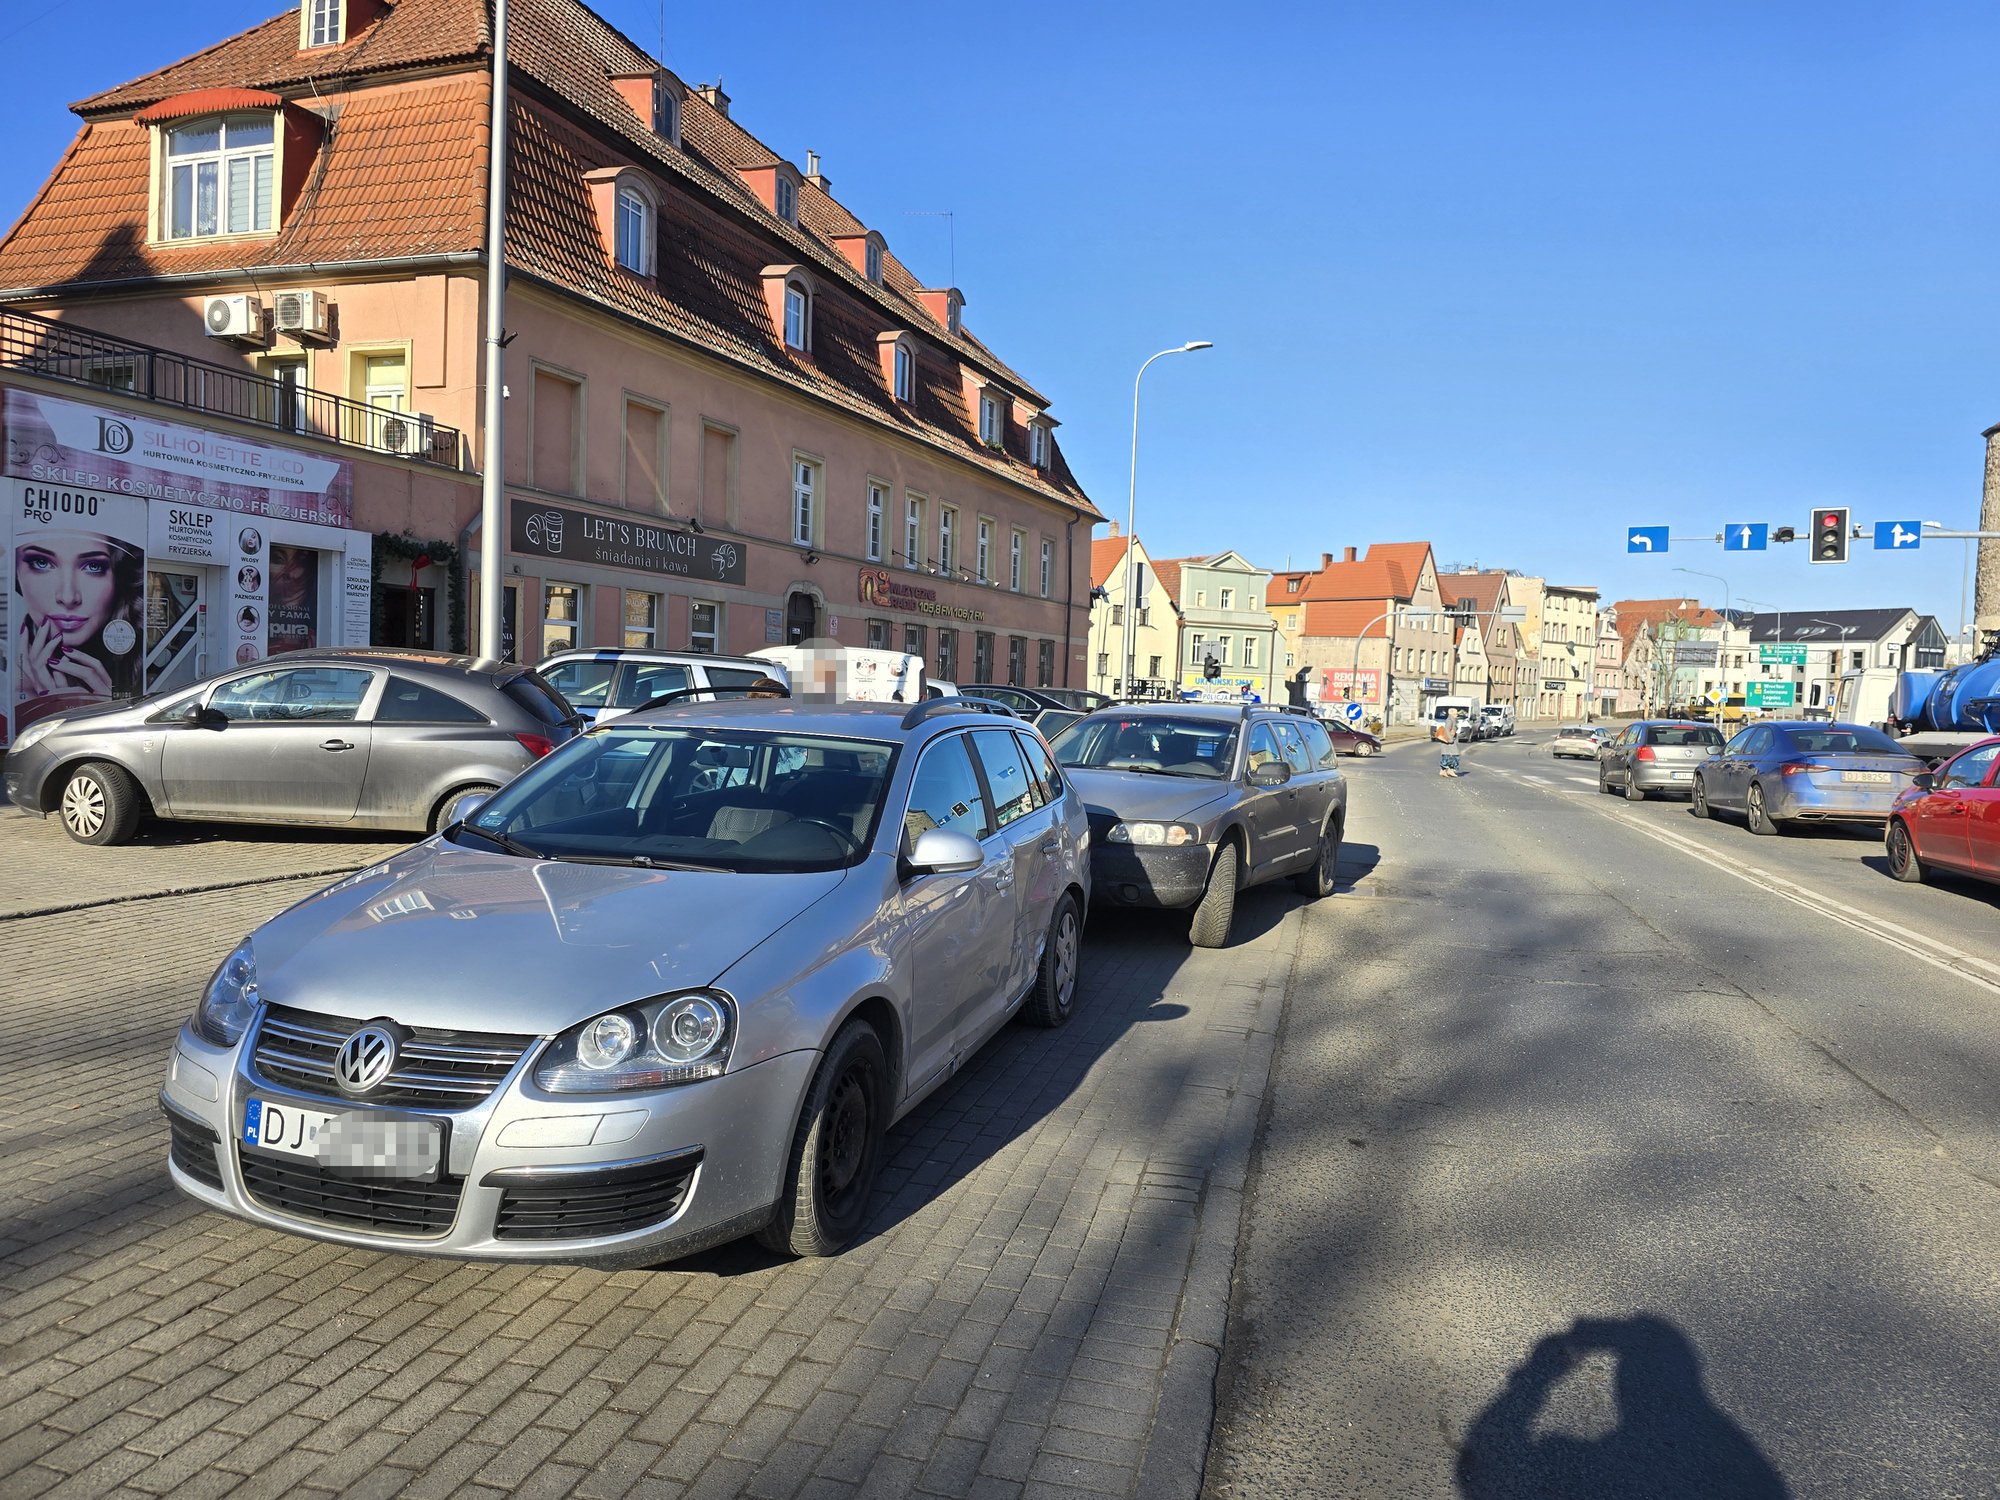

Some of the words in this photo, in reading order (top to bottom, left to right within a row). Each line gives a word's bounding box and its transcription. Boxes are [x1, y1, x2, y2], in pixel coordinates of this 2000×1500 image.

[143, 430, 262, 467] SILHOUETTE
[143, 449, 195, 466] HURTOWNIA
[196, 459, 305, 486] KOSMETYCZNO-FRYZJERSKA
[24, 487, 98, 516] CHIODO
[31, 464, 100, 487] SKLEP
[107, 476, 342, 526] KOSMETYCZNO-FRYZJERSKI
[24, 509, 52, 524] PRO
[169, 510, 213, 528] SKLEP
[169, 526, 212, 537] HURTOWNIA
[583, 517, 630, 545] LET'S
[635, 528, 697, 557] BRUNCH
[169, 534, 212, 545] KOSMETYCZNO
[168, 545, 212, 557] FRYZJERSKA
[595, 547, 651, 568] śniadania
[655, 556, 660, 569] i
[663, 558, 688, 574] kawa
[346, 584, 370, 592] POKAZY
[279, 611, 311, 620] FAMA
[269, 623, 309, 638] pura
[1202, 693, 1229, 701] POLICJA
[247, 1126, 258, 1139] PL
